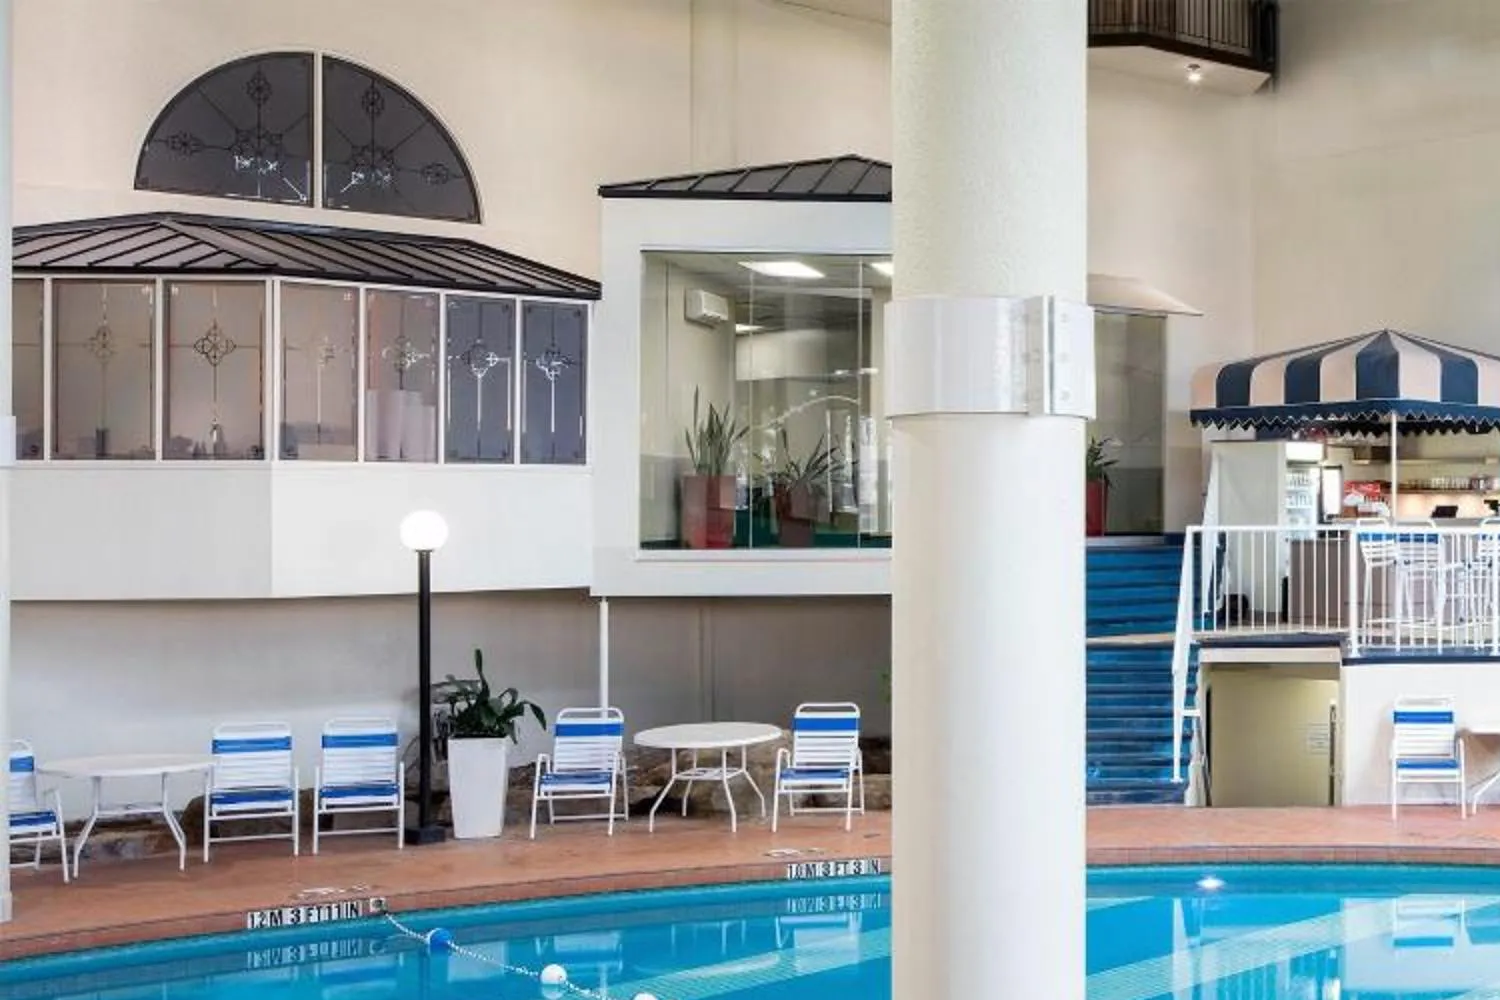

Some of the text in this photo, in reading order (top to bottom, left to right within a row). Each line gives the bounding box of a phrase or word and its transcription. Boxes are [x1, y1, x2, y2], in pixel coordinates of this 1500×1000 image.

[853, 859, 863, 875] 3
[289, 908, 301, 924] 3
[306, 905, 321, 922] FT
